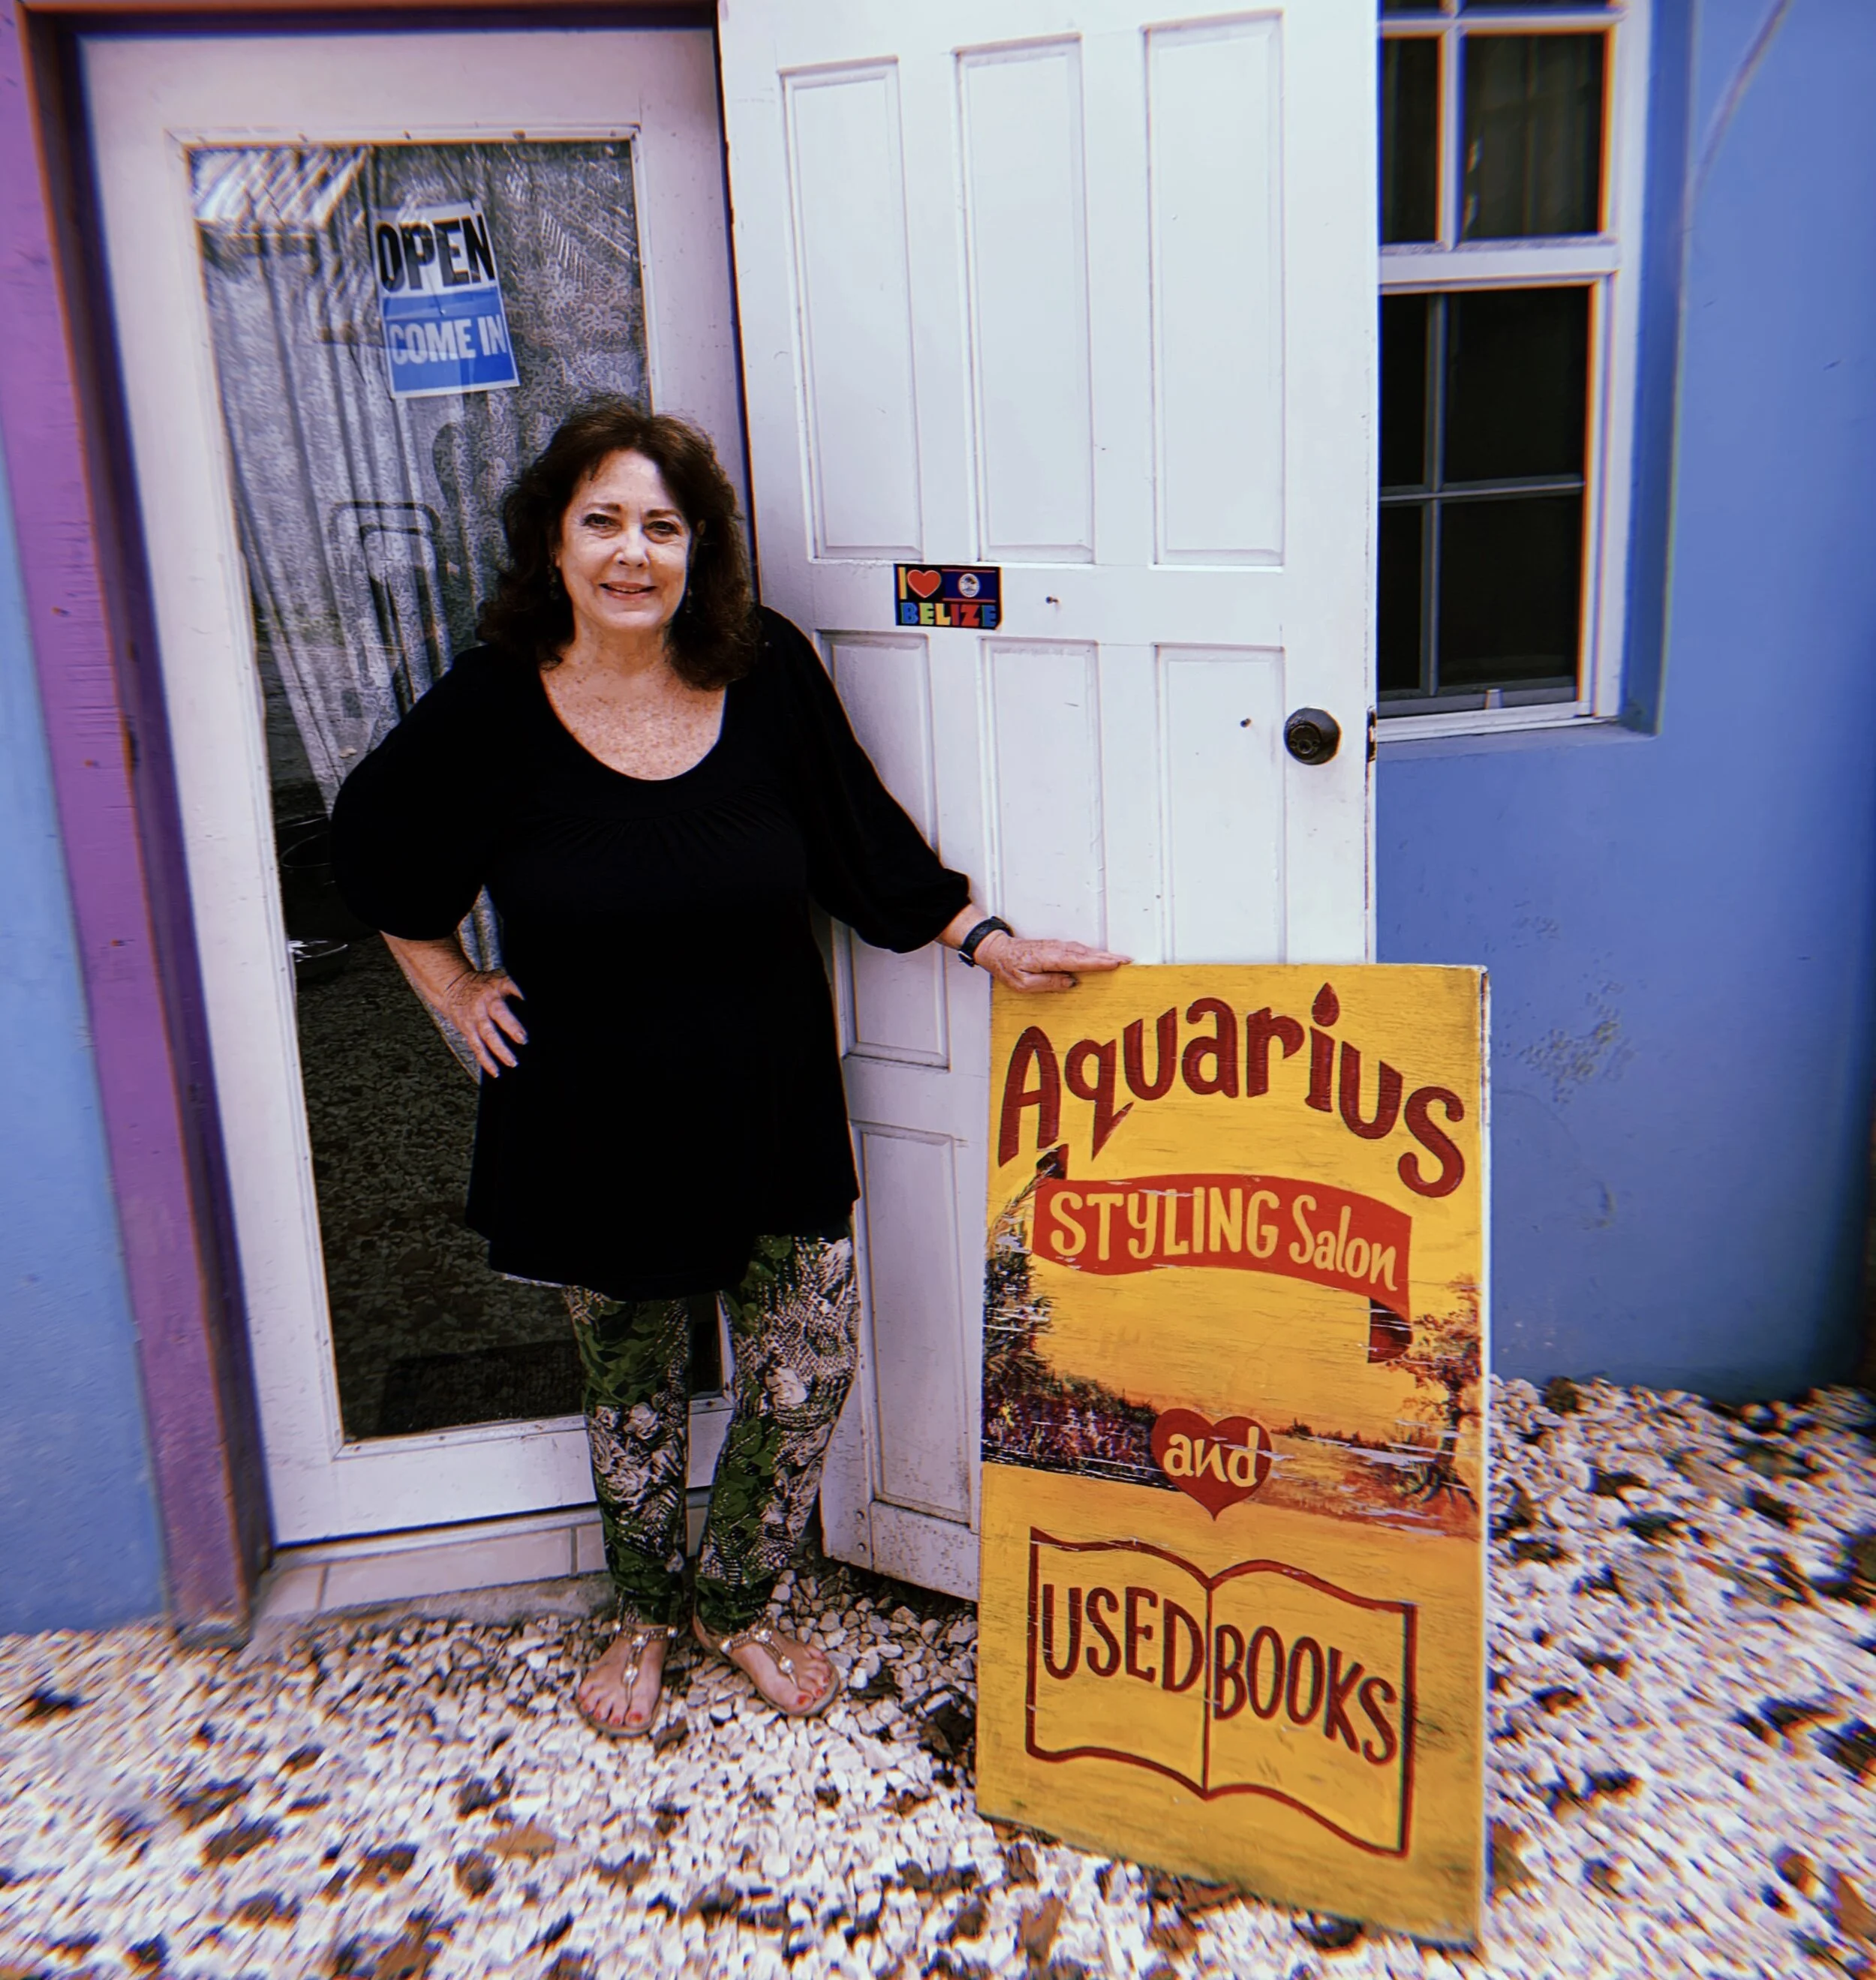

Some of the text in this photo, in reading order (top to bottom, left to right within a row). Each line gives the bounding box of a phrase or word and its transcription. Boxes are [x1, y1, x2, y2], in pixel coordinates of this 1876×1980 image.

[377, 212, 495, 292] OPEN
[389, 315, 507, 365] COME IN
[897, 566, 907, 599] I
[900, 602, 997, 627] BELIZE
[997, 982, 1466, 1198] Aquarius
[1288, 1194, 1398, 1291] Salon
[1163, 1426, 1261, 1488] and
[1042, 1583, 1397, 1765] USED BOOKS
